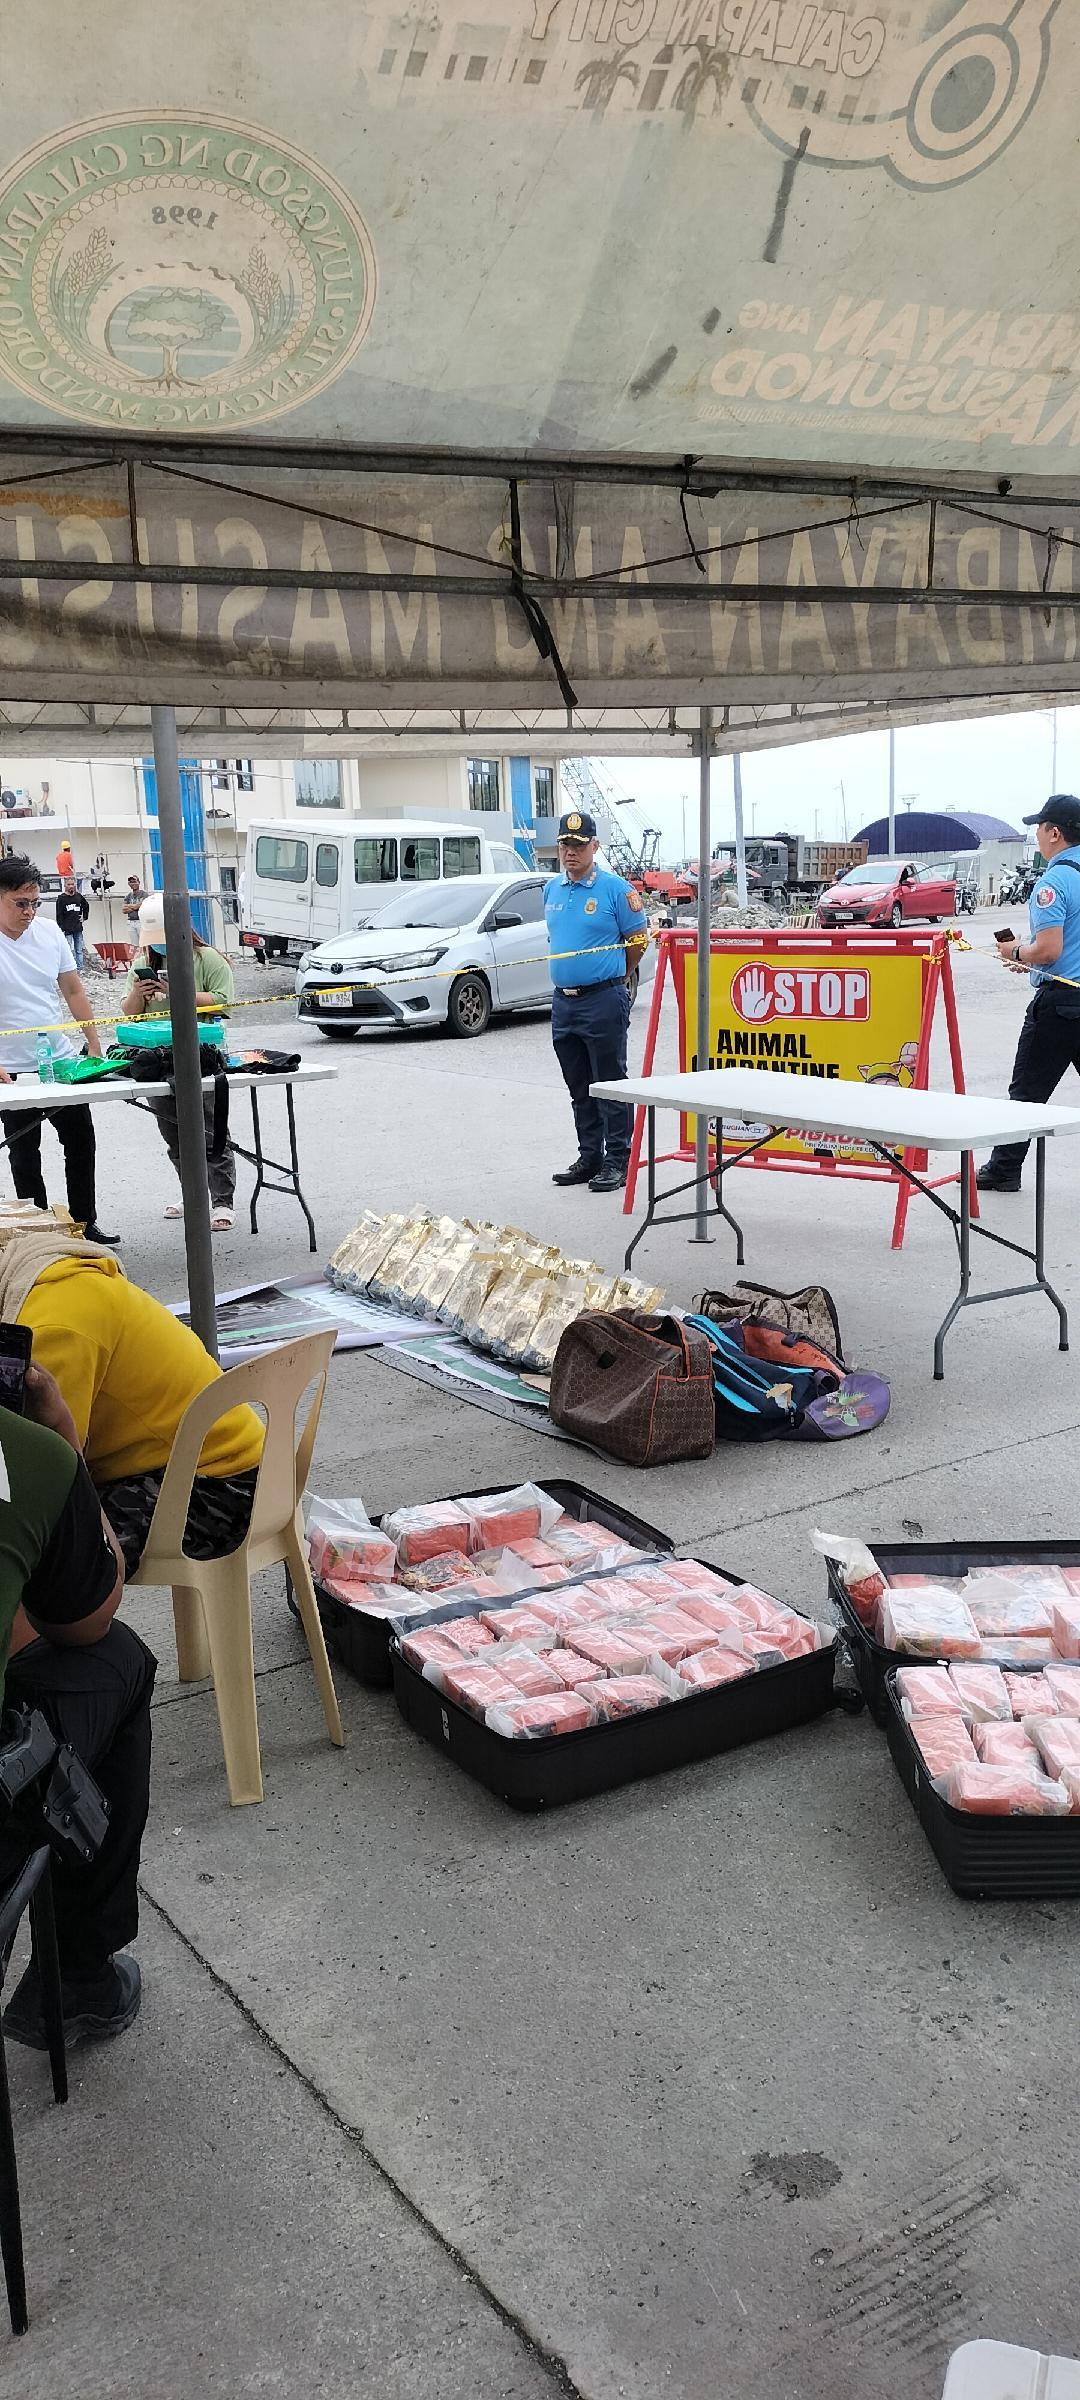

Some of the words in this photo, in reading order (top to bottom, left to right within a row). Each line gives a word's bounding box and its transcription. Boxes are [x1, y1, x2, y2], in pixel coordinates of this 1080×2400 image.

[774, 972, 867, 1017] STOP
[716, 1028, 813, 1059] ANIMAL
[691, 1054, 840, 1079] UNTINE
